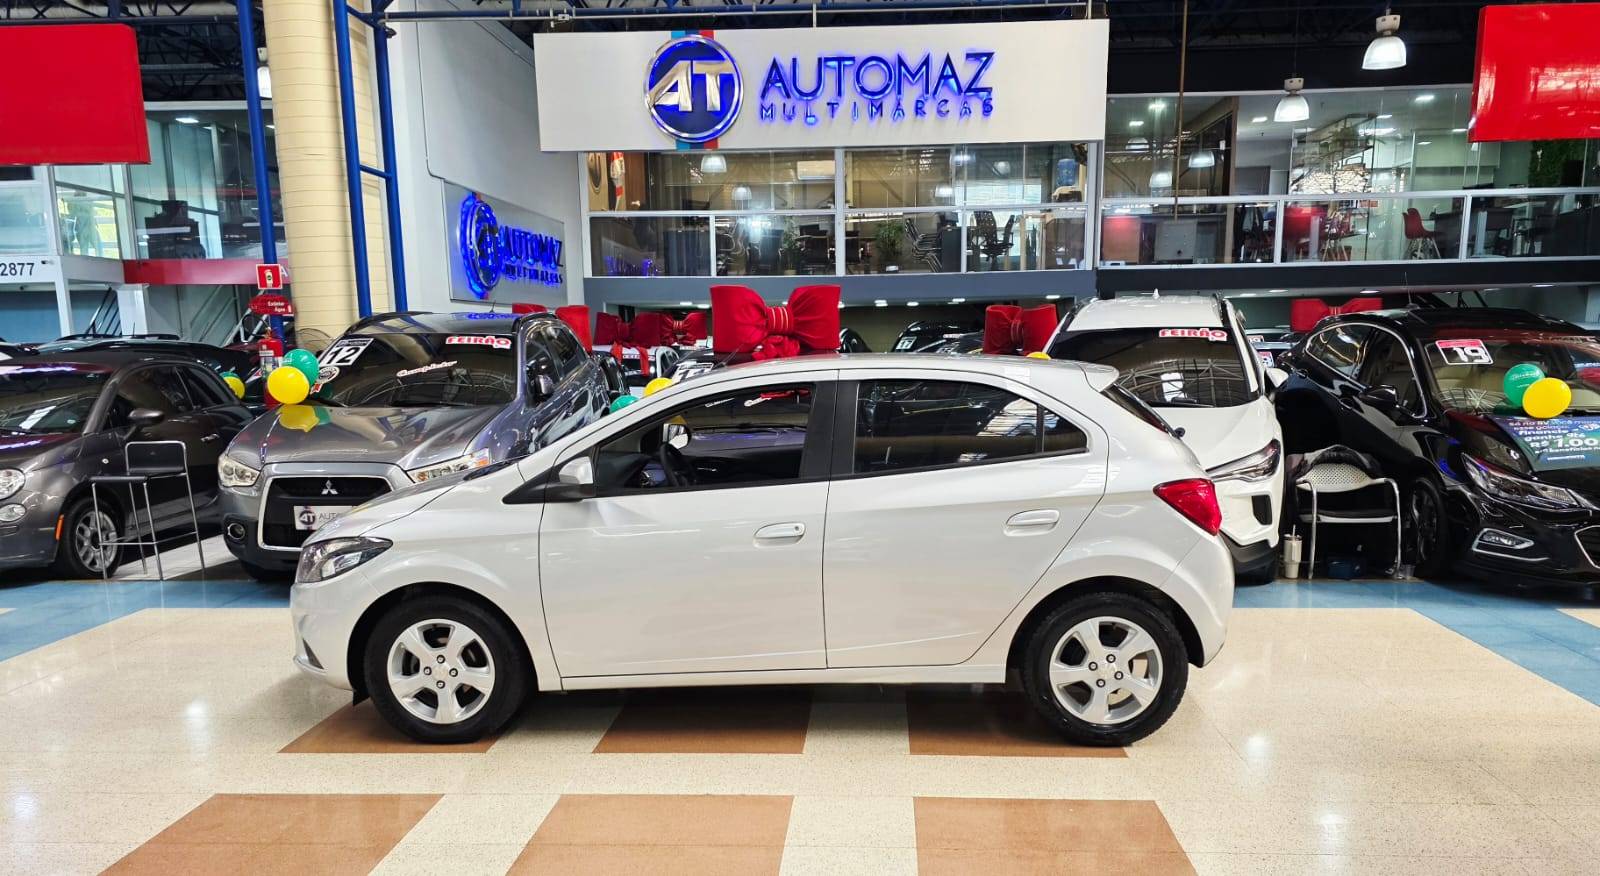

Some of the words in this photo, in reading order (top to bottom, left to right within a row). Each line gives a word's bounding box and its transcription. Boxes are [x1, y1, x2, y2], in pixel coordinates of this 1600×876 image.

[759, 52, 995, 100] AUTOMAZ
[645, 59, 736, 112] AT
[760, 98, 993, 121] MULTIMARCAS
[502, 226, 563, 268] AUTOMAZ
[0, 263, 35, 276] 2877
[446, 335, 511, 349] FEIRÃO
[1159, 327, 1227, 340] FEIRÃO
[328, 346, 361, 364] 12
[1453, 346, 1490, 362] 19
[1530, 440, 1550, 448] R$
